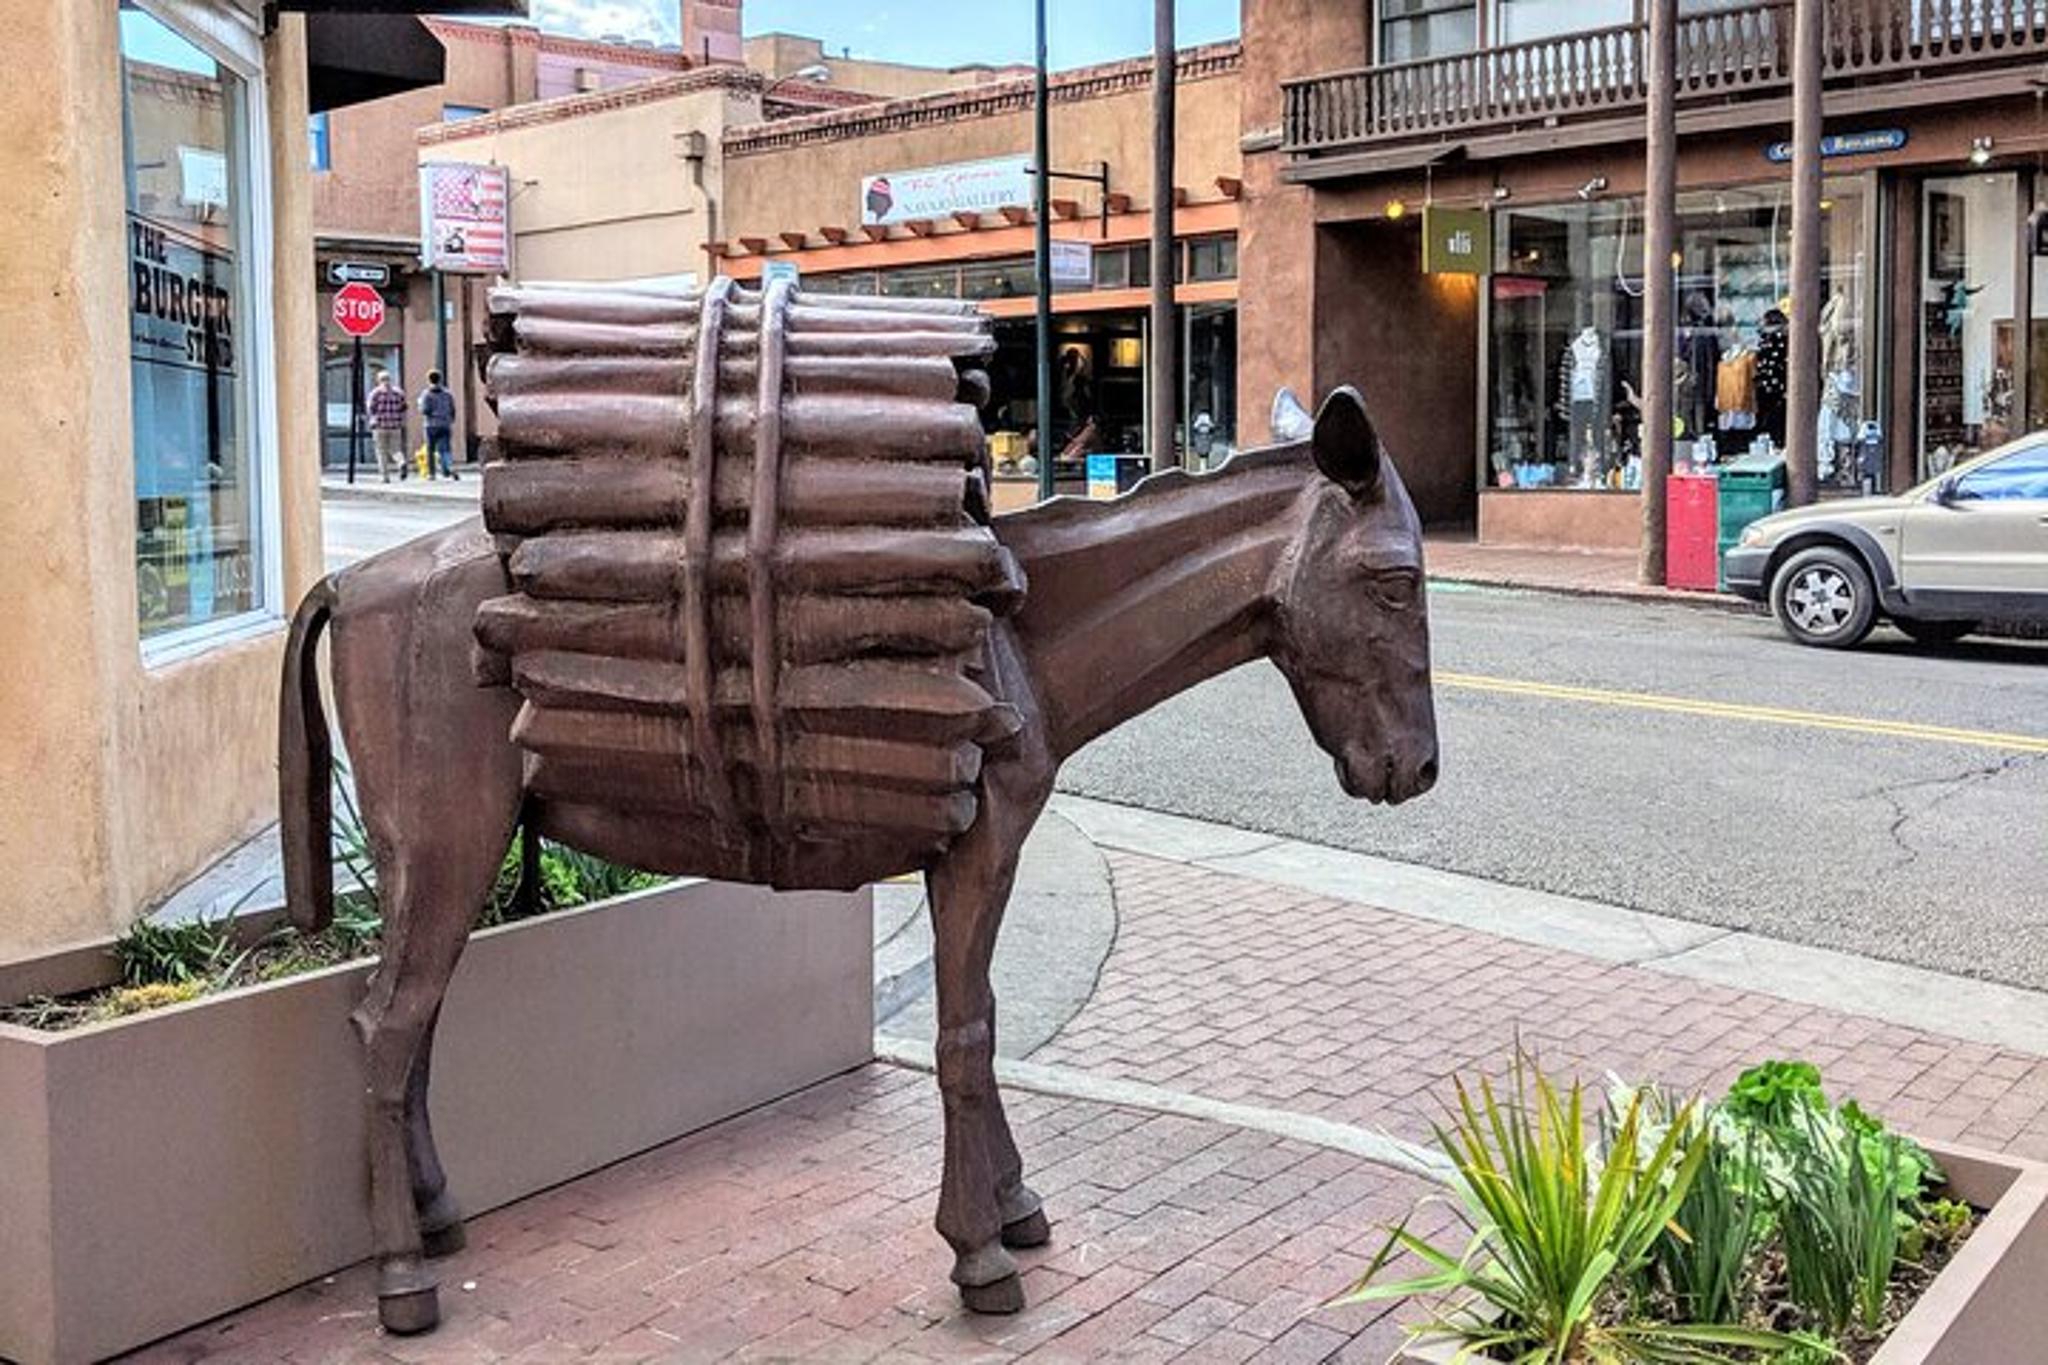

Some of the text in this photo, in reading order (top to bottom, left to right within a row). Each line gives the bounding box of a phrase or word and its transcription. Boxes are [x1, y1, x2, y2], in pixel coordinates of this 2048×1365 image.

[133, 222, 167, 265] THE
[133, 261, 231, 336] BURGER
[335, 298, 382, 319] STOP
